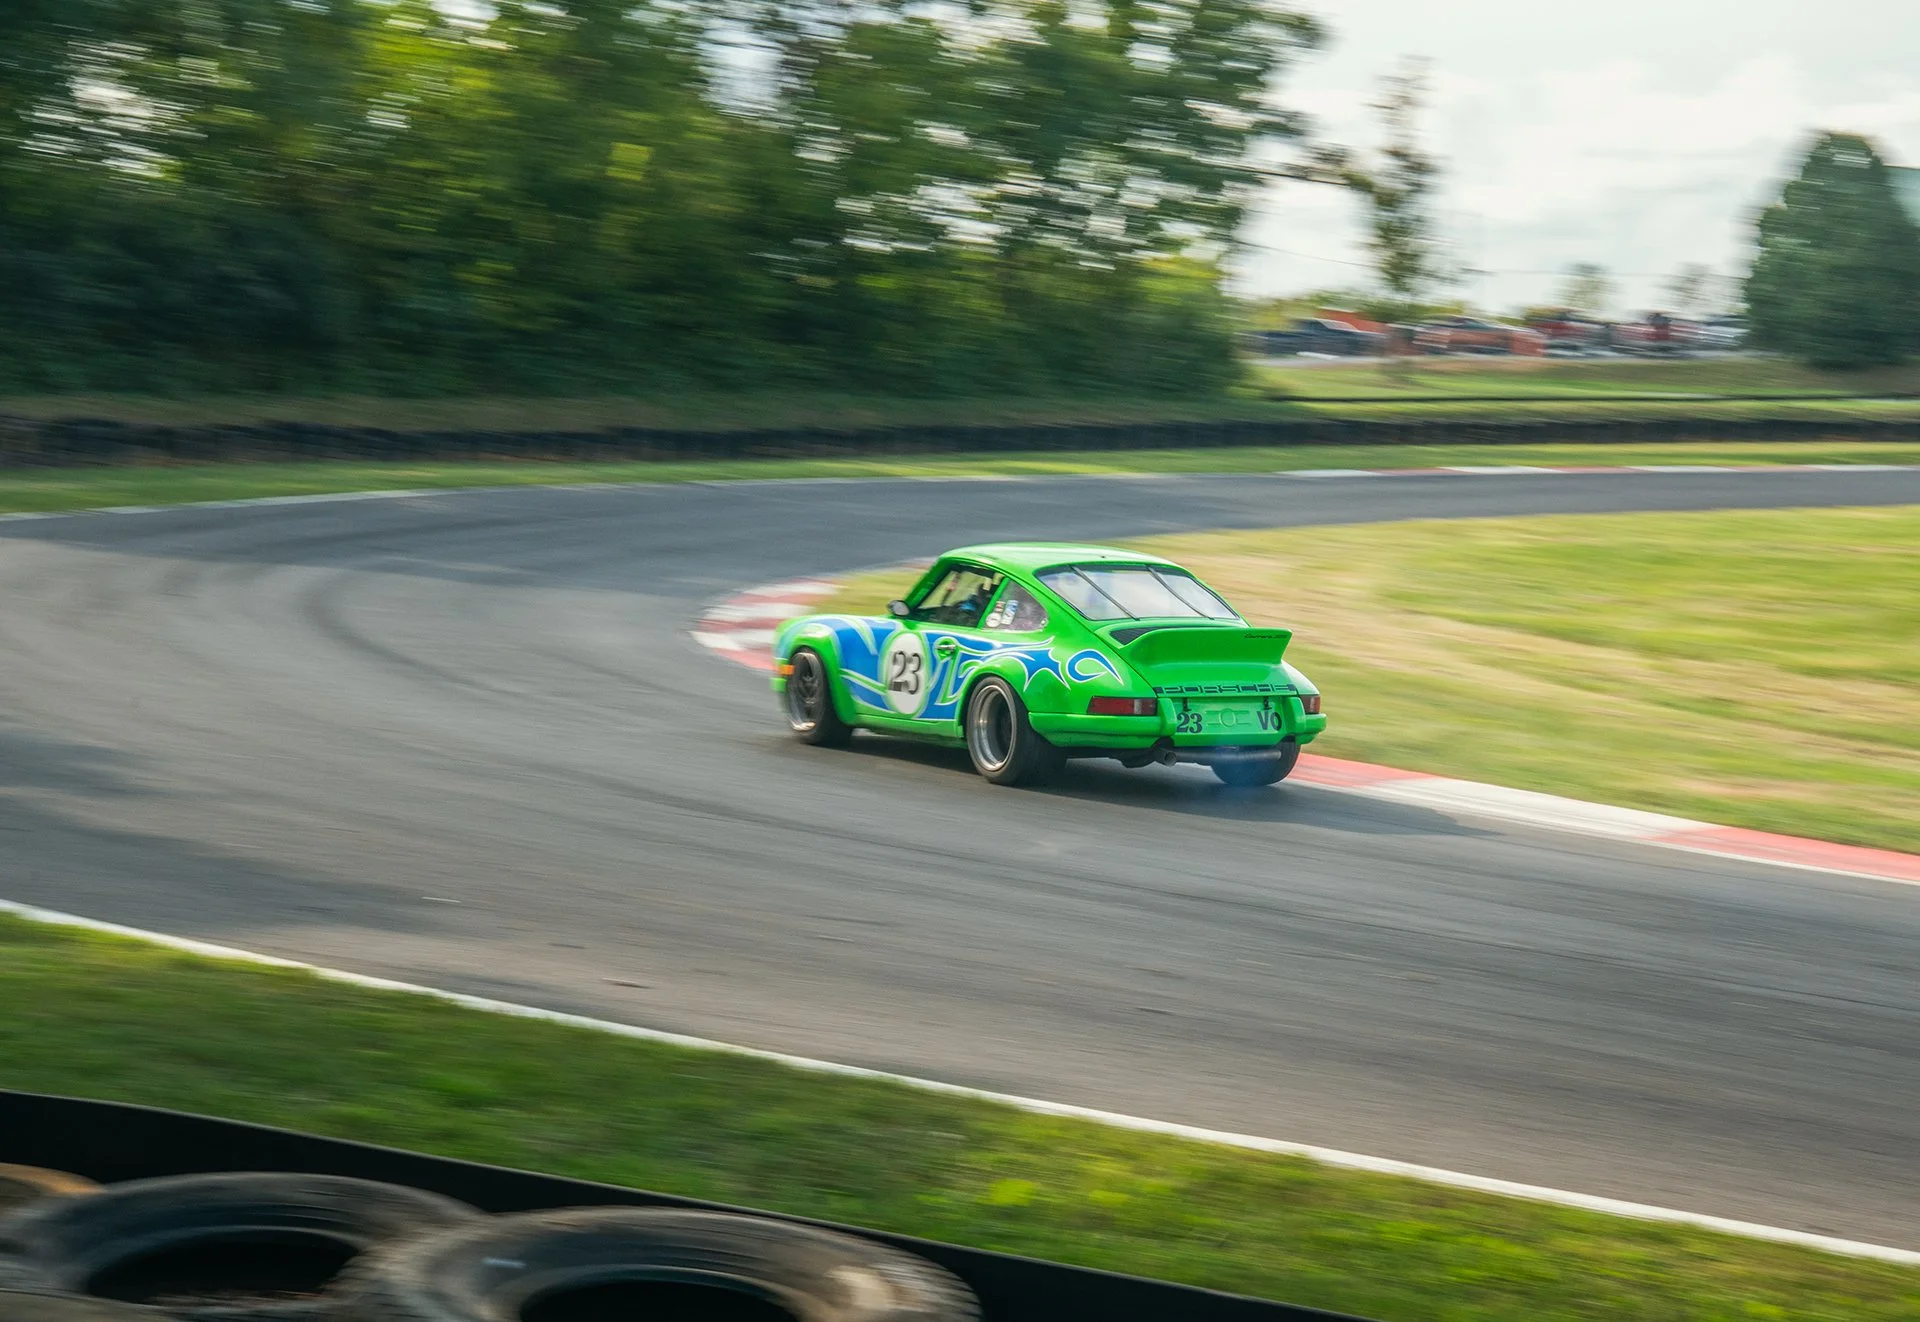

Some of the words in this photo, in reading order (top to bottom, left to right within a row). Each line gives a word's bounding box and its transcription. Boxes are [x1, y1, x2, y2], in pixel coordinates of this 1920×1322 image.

[888, 650, 921, 695] 23
[1161, 683, 1290, 694] PORSCHE
[1176, 712, 1203, 734] 23
